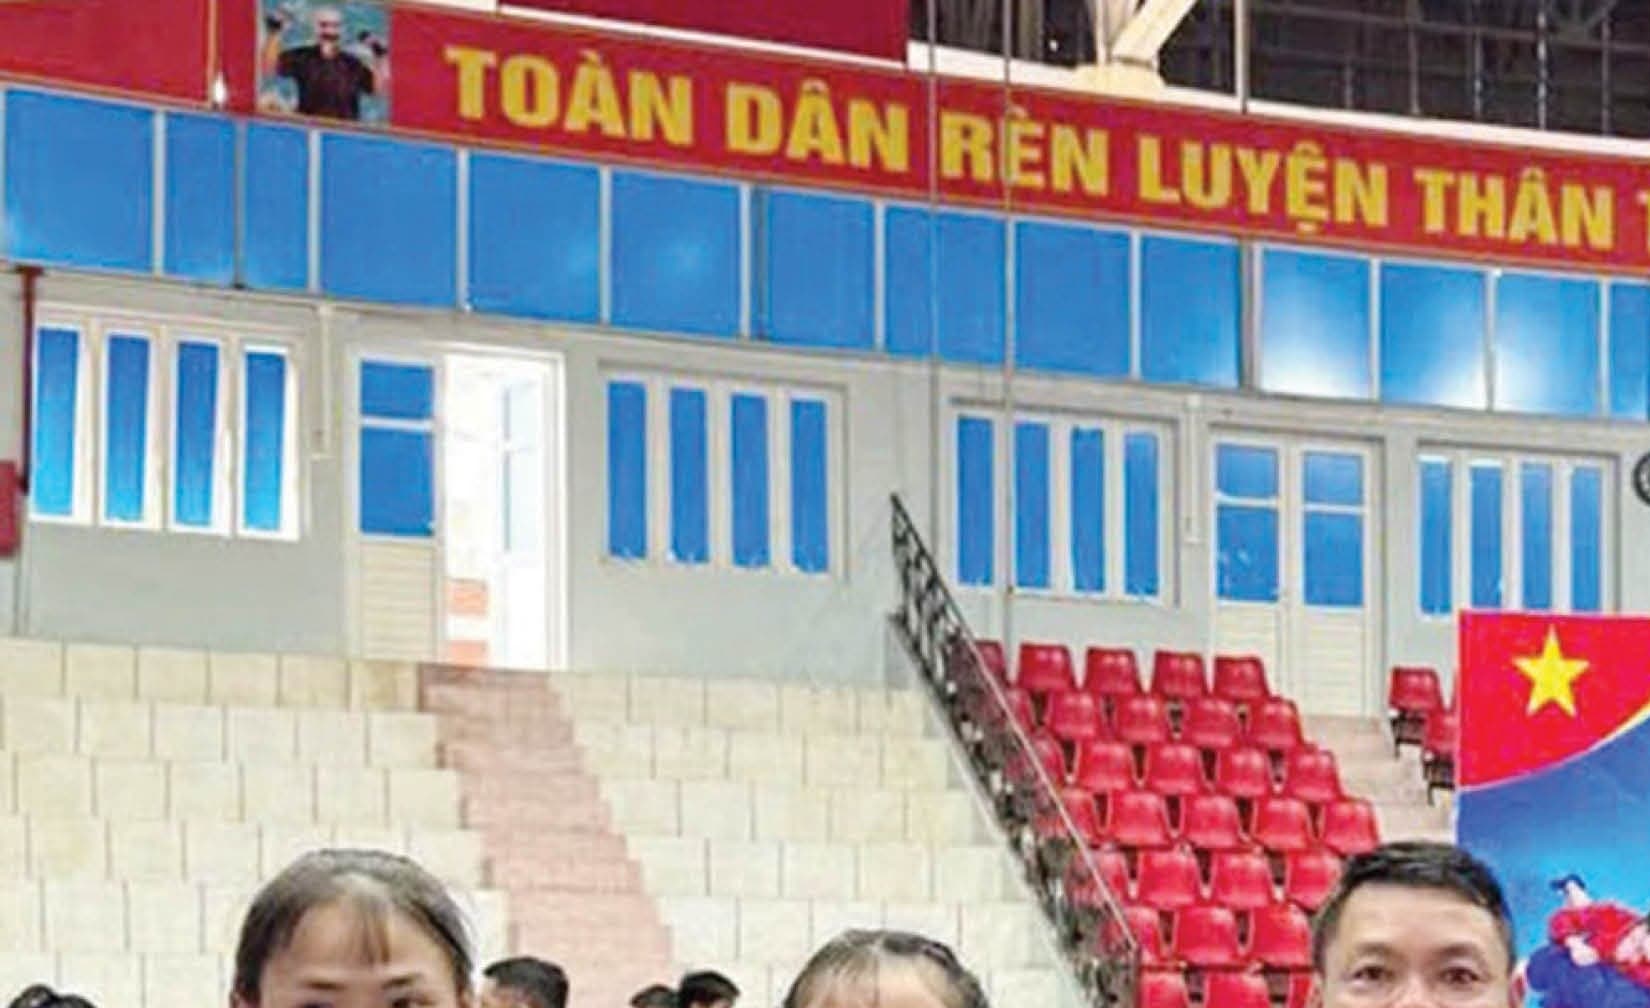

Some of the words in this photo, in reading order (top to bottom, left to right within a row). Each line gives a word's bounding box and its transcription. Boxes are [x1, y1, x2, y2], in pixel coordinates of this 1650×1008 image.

[444, 45, 693, 147] TOÀN
[725, 78, 909, 175] DÂN
[938, 105, 1108, 197] RÈN
[1137, 140, 1388, 232] LUYỆN
[1414, 166, 1613, 251] THÂN
